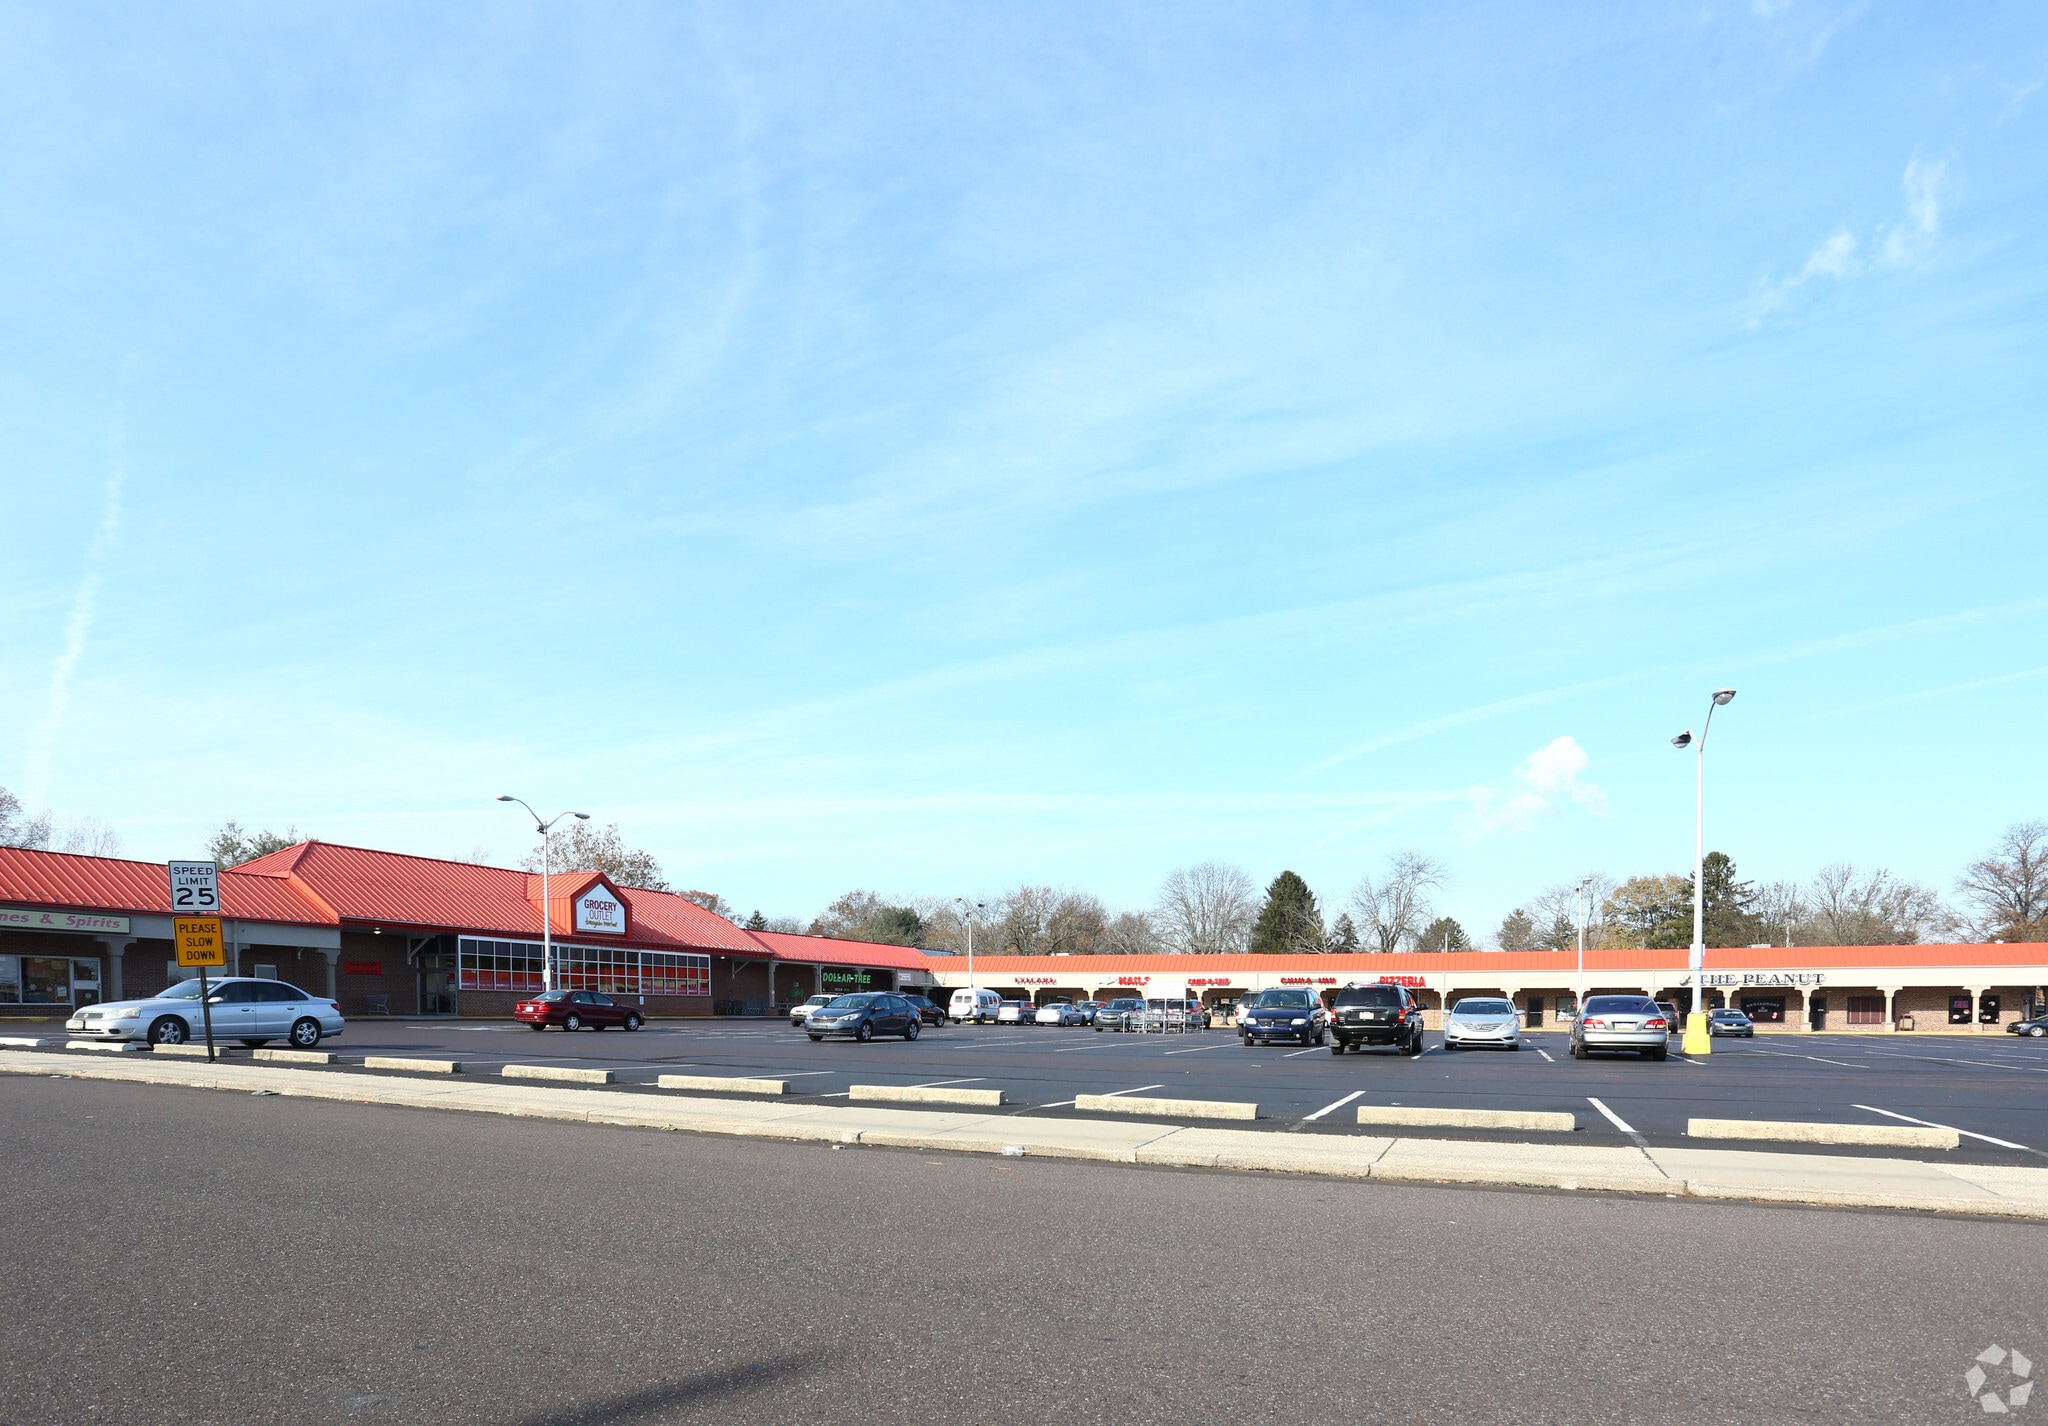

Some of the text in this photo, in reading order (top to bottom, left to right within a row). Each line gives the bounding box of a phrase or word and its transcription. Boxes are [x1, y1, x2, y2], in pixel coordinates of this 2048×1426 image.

[173, 866, 214, 875] SPEED
[178, 877, 210, 885] LIMIT
[176, 887, 215, 905] 25
[584, 899, 617, 911] GROCERY
[589, 909, 613, 921] OUTLET
[39, 913, 54, 924] &
[66, 915, 121, 929] Spirits
[179, 923, 217, 934] PLEASE
[186, 937, 213, 947] SLOW
[186, 950, 215, 961] DOWN
[822, 972, 871, 984] DOLLAR TREE
[1379, 976, 1427, 987] PIZZERIA
[1743, 973, 1825, 986] PEANUT
